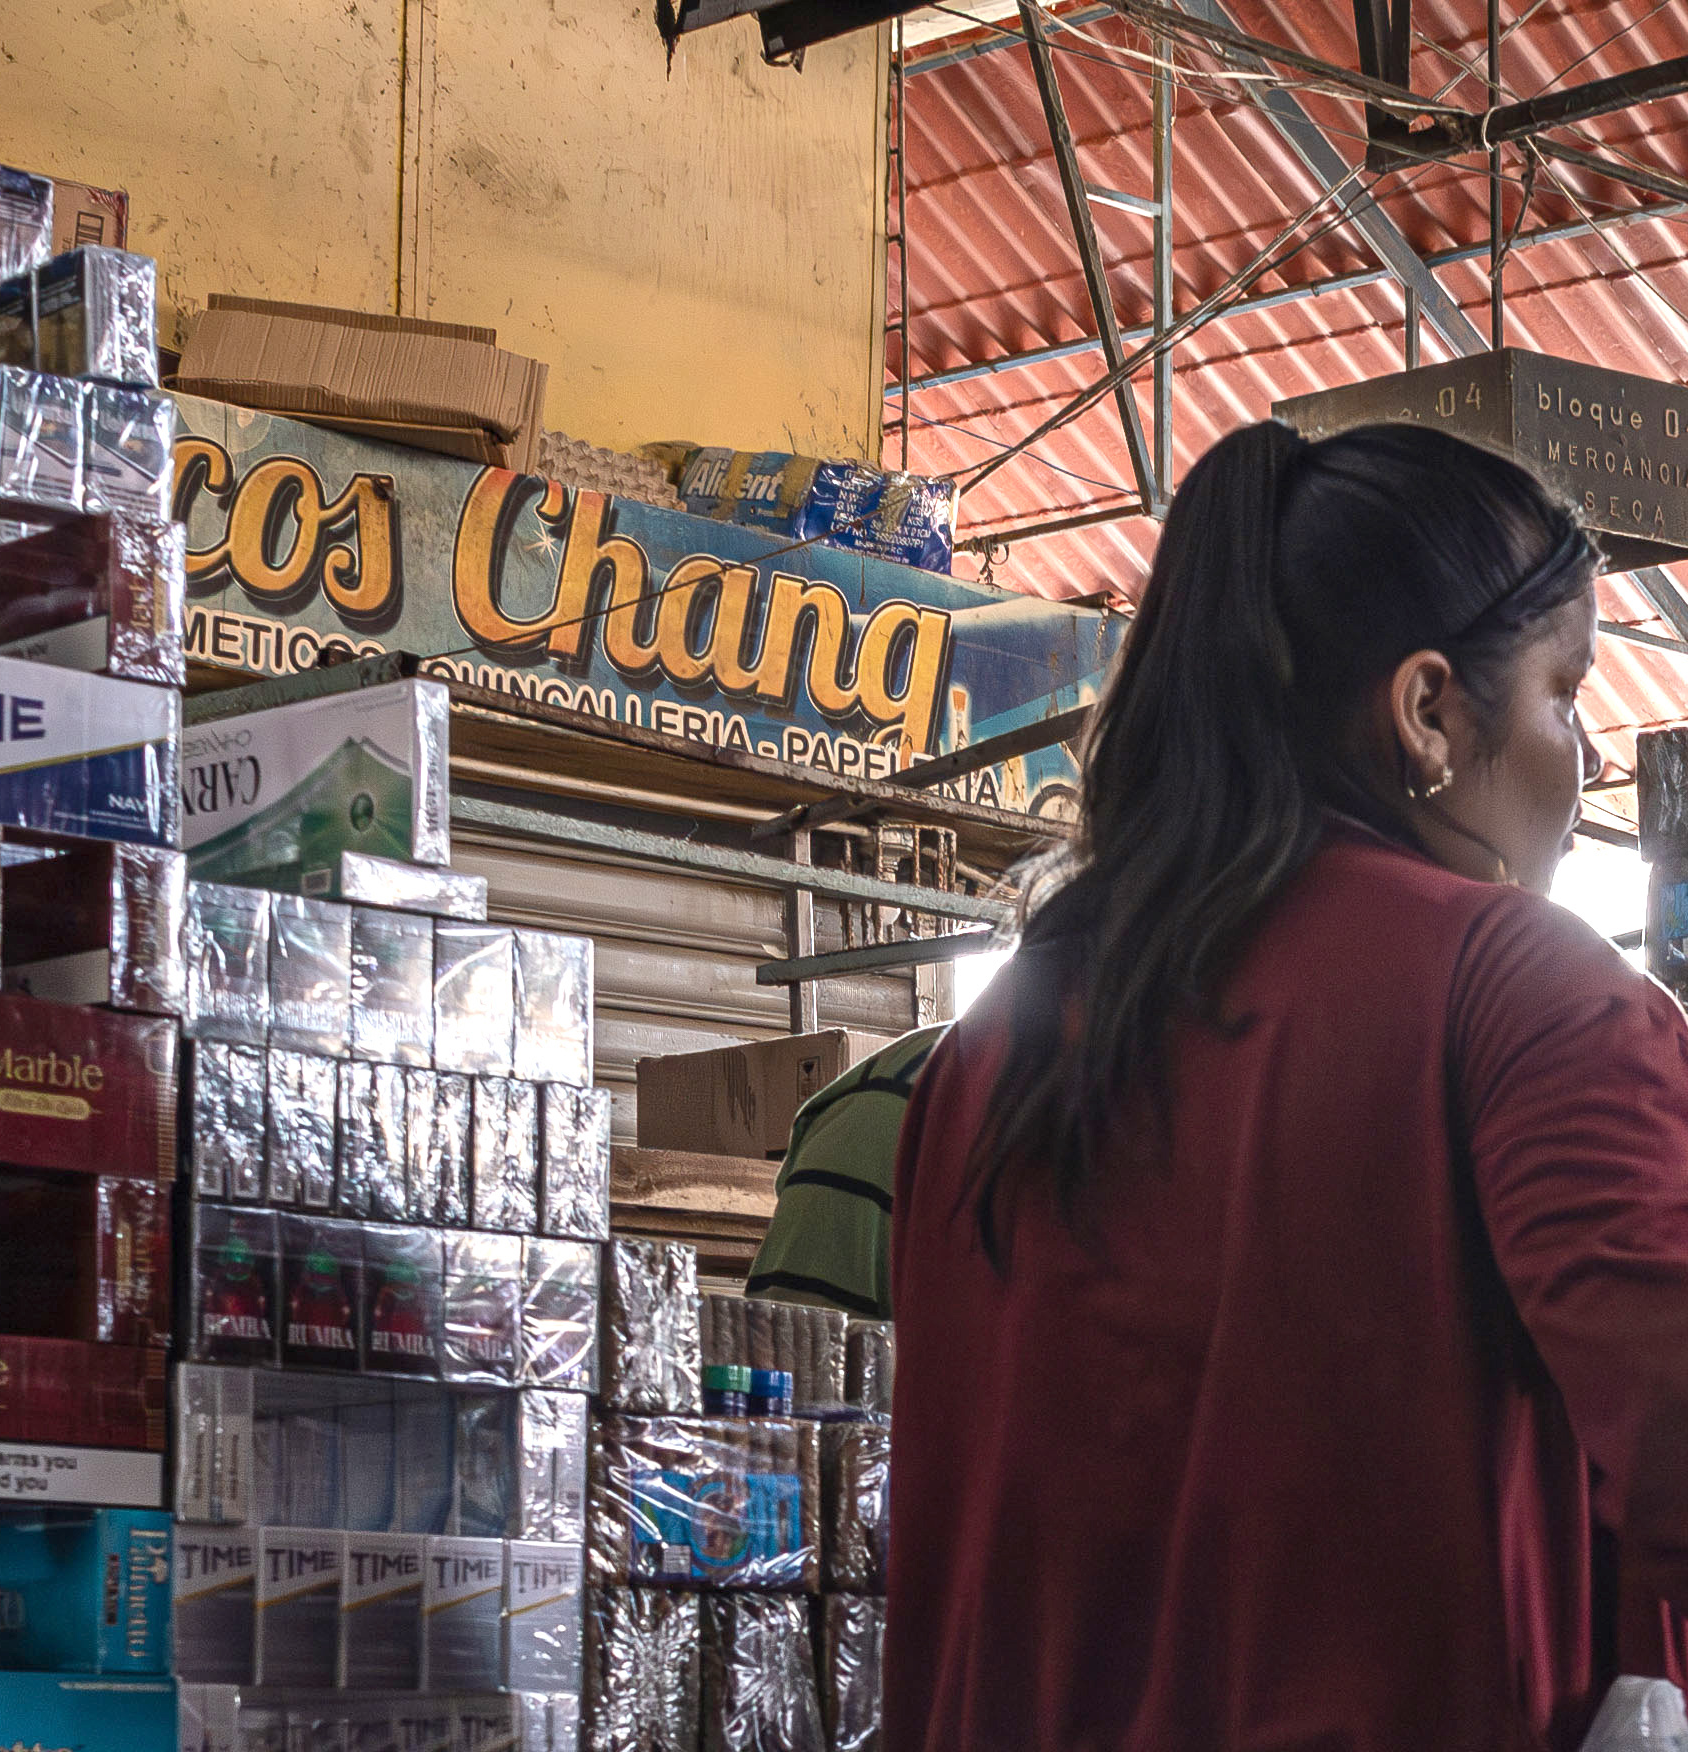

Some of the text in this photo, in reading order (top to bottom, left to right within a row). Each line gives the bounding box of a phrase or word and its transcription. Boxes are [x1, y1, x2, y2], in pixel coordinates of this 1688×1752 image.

[1537, 384, 1643, 431] bloque
[451, 466, 957, 768] Chang
[287, 1323, 356, 1350] RUMBA
[40, 1451, 77, 1476] you
[13, 1472, 48, 1495] you
[180, 1543, 253, 1579] TIME
[265, 1548, 340, 1584] TIME
[350, 1550, 420, 1585] TIME
[432, 1555, 499, 1590] TIME
